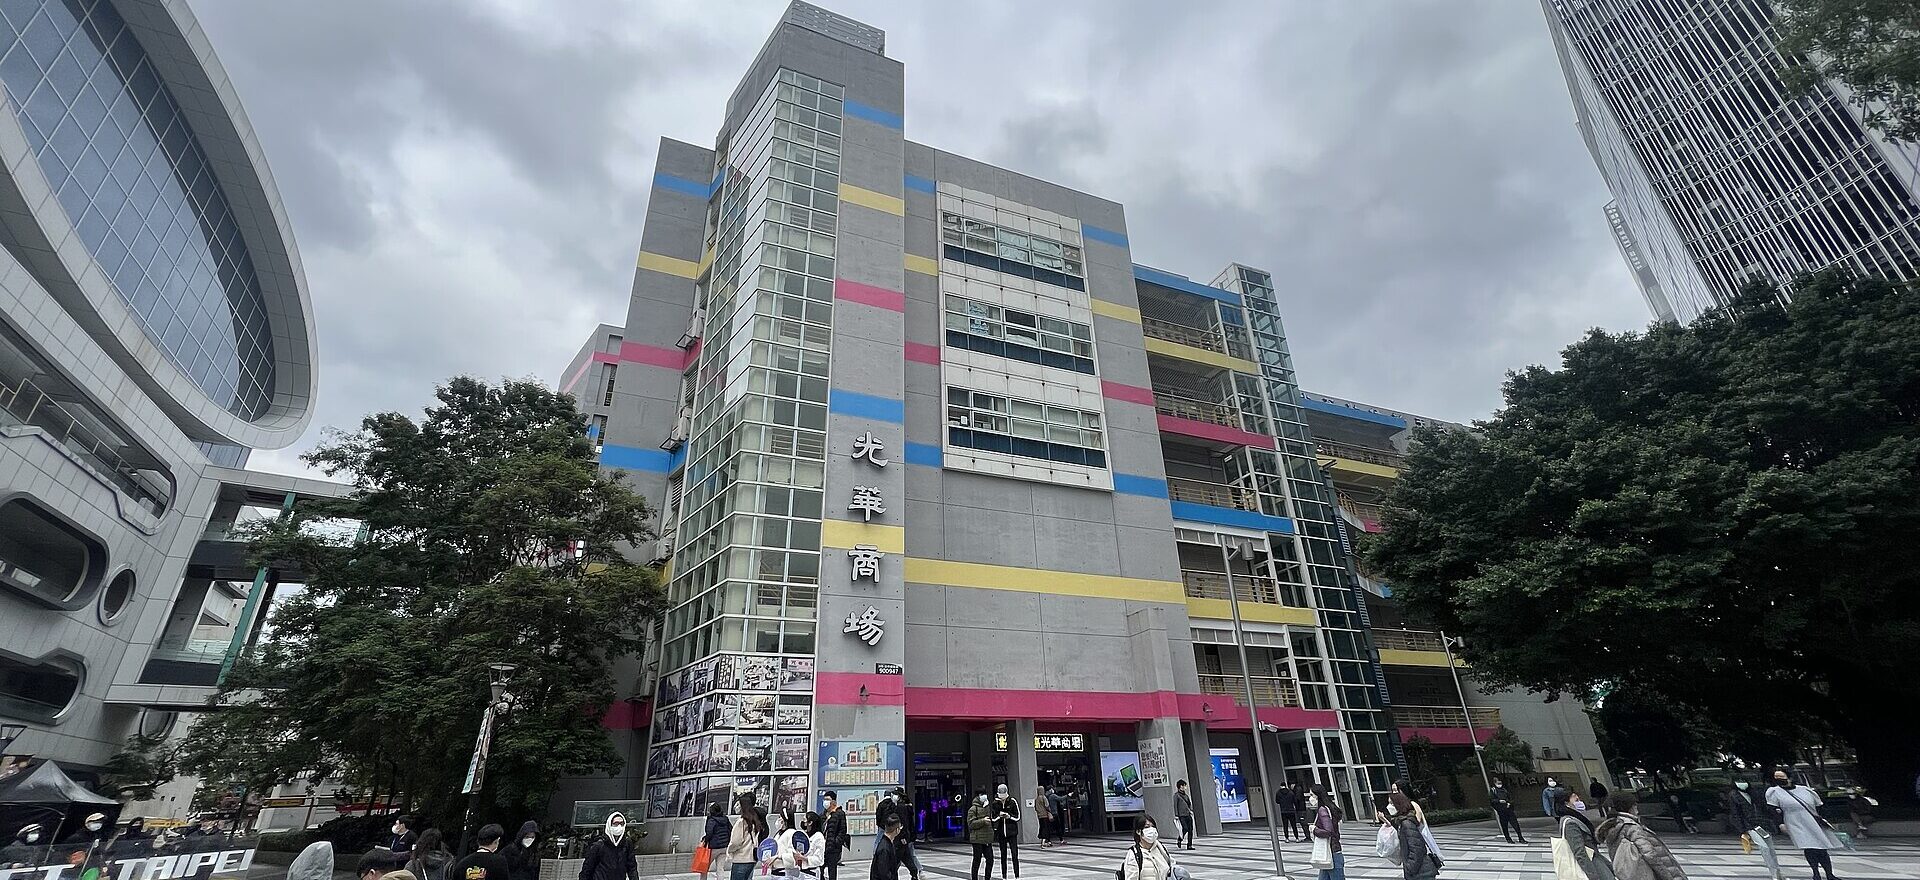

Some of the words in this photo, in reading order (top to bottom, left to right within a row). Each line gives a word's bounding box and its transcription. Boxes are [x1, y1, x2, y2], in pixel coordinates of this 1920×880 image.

[843, 431, 889, 647] 光華商場
[114, 849, 255, 880] TAIPEI
